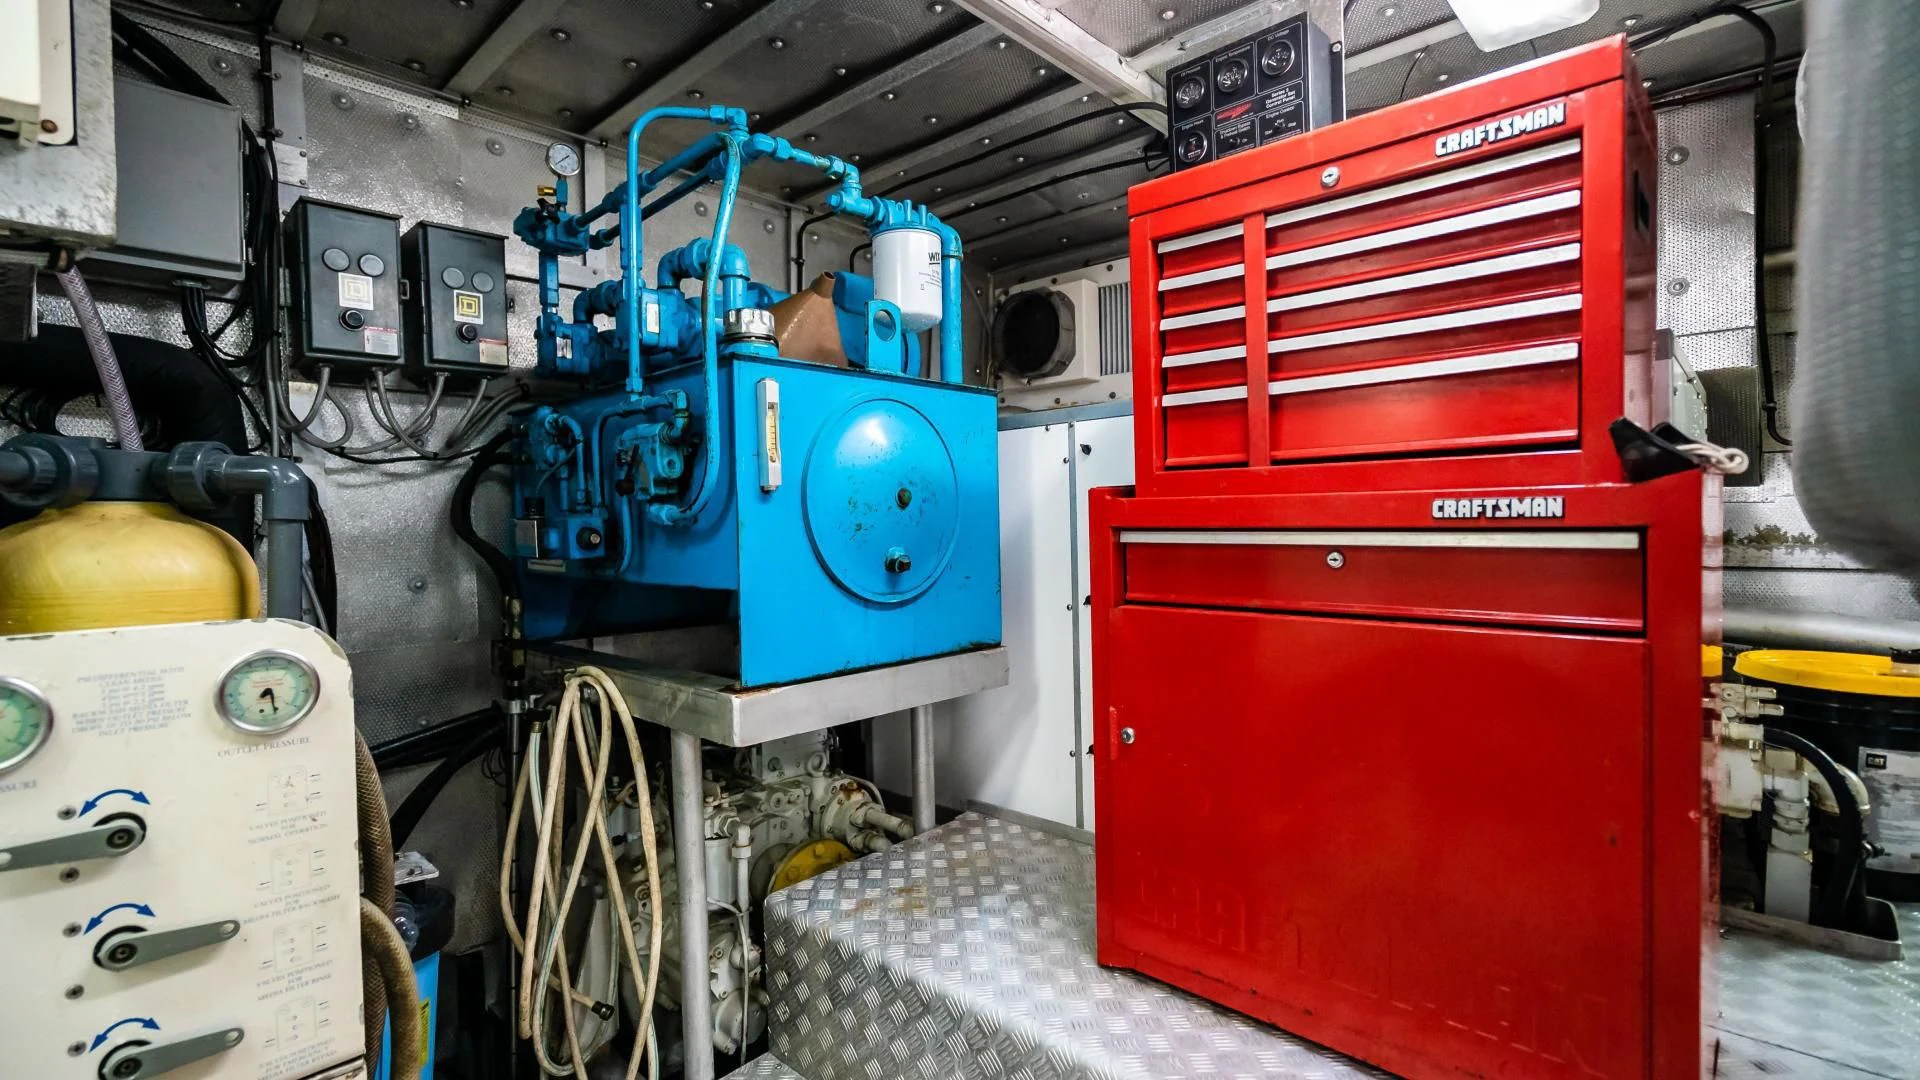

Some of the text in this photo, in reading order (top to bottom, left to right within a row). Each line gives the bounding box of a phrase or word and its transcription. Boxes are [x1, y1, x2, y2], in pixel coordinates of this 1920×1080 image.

[1435, 102, 1566, 157] CRAFTSMAN
[1431, 496, 1564, 519] CRAFTSMAN
[263, 736, 310, 751] PRESSURE
